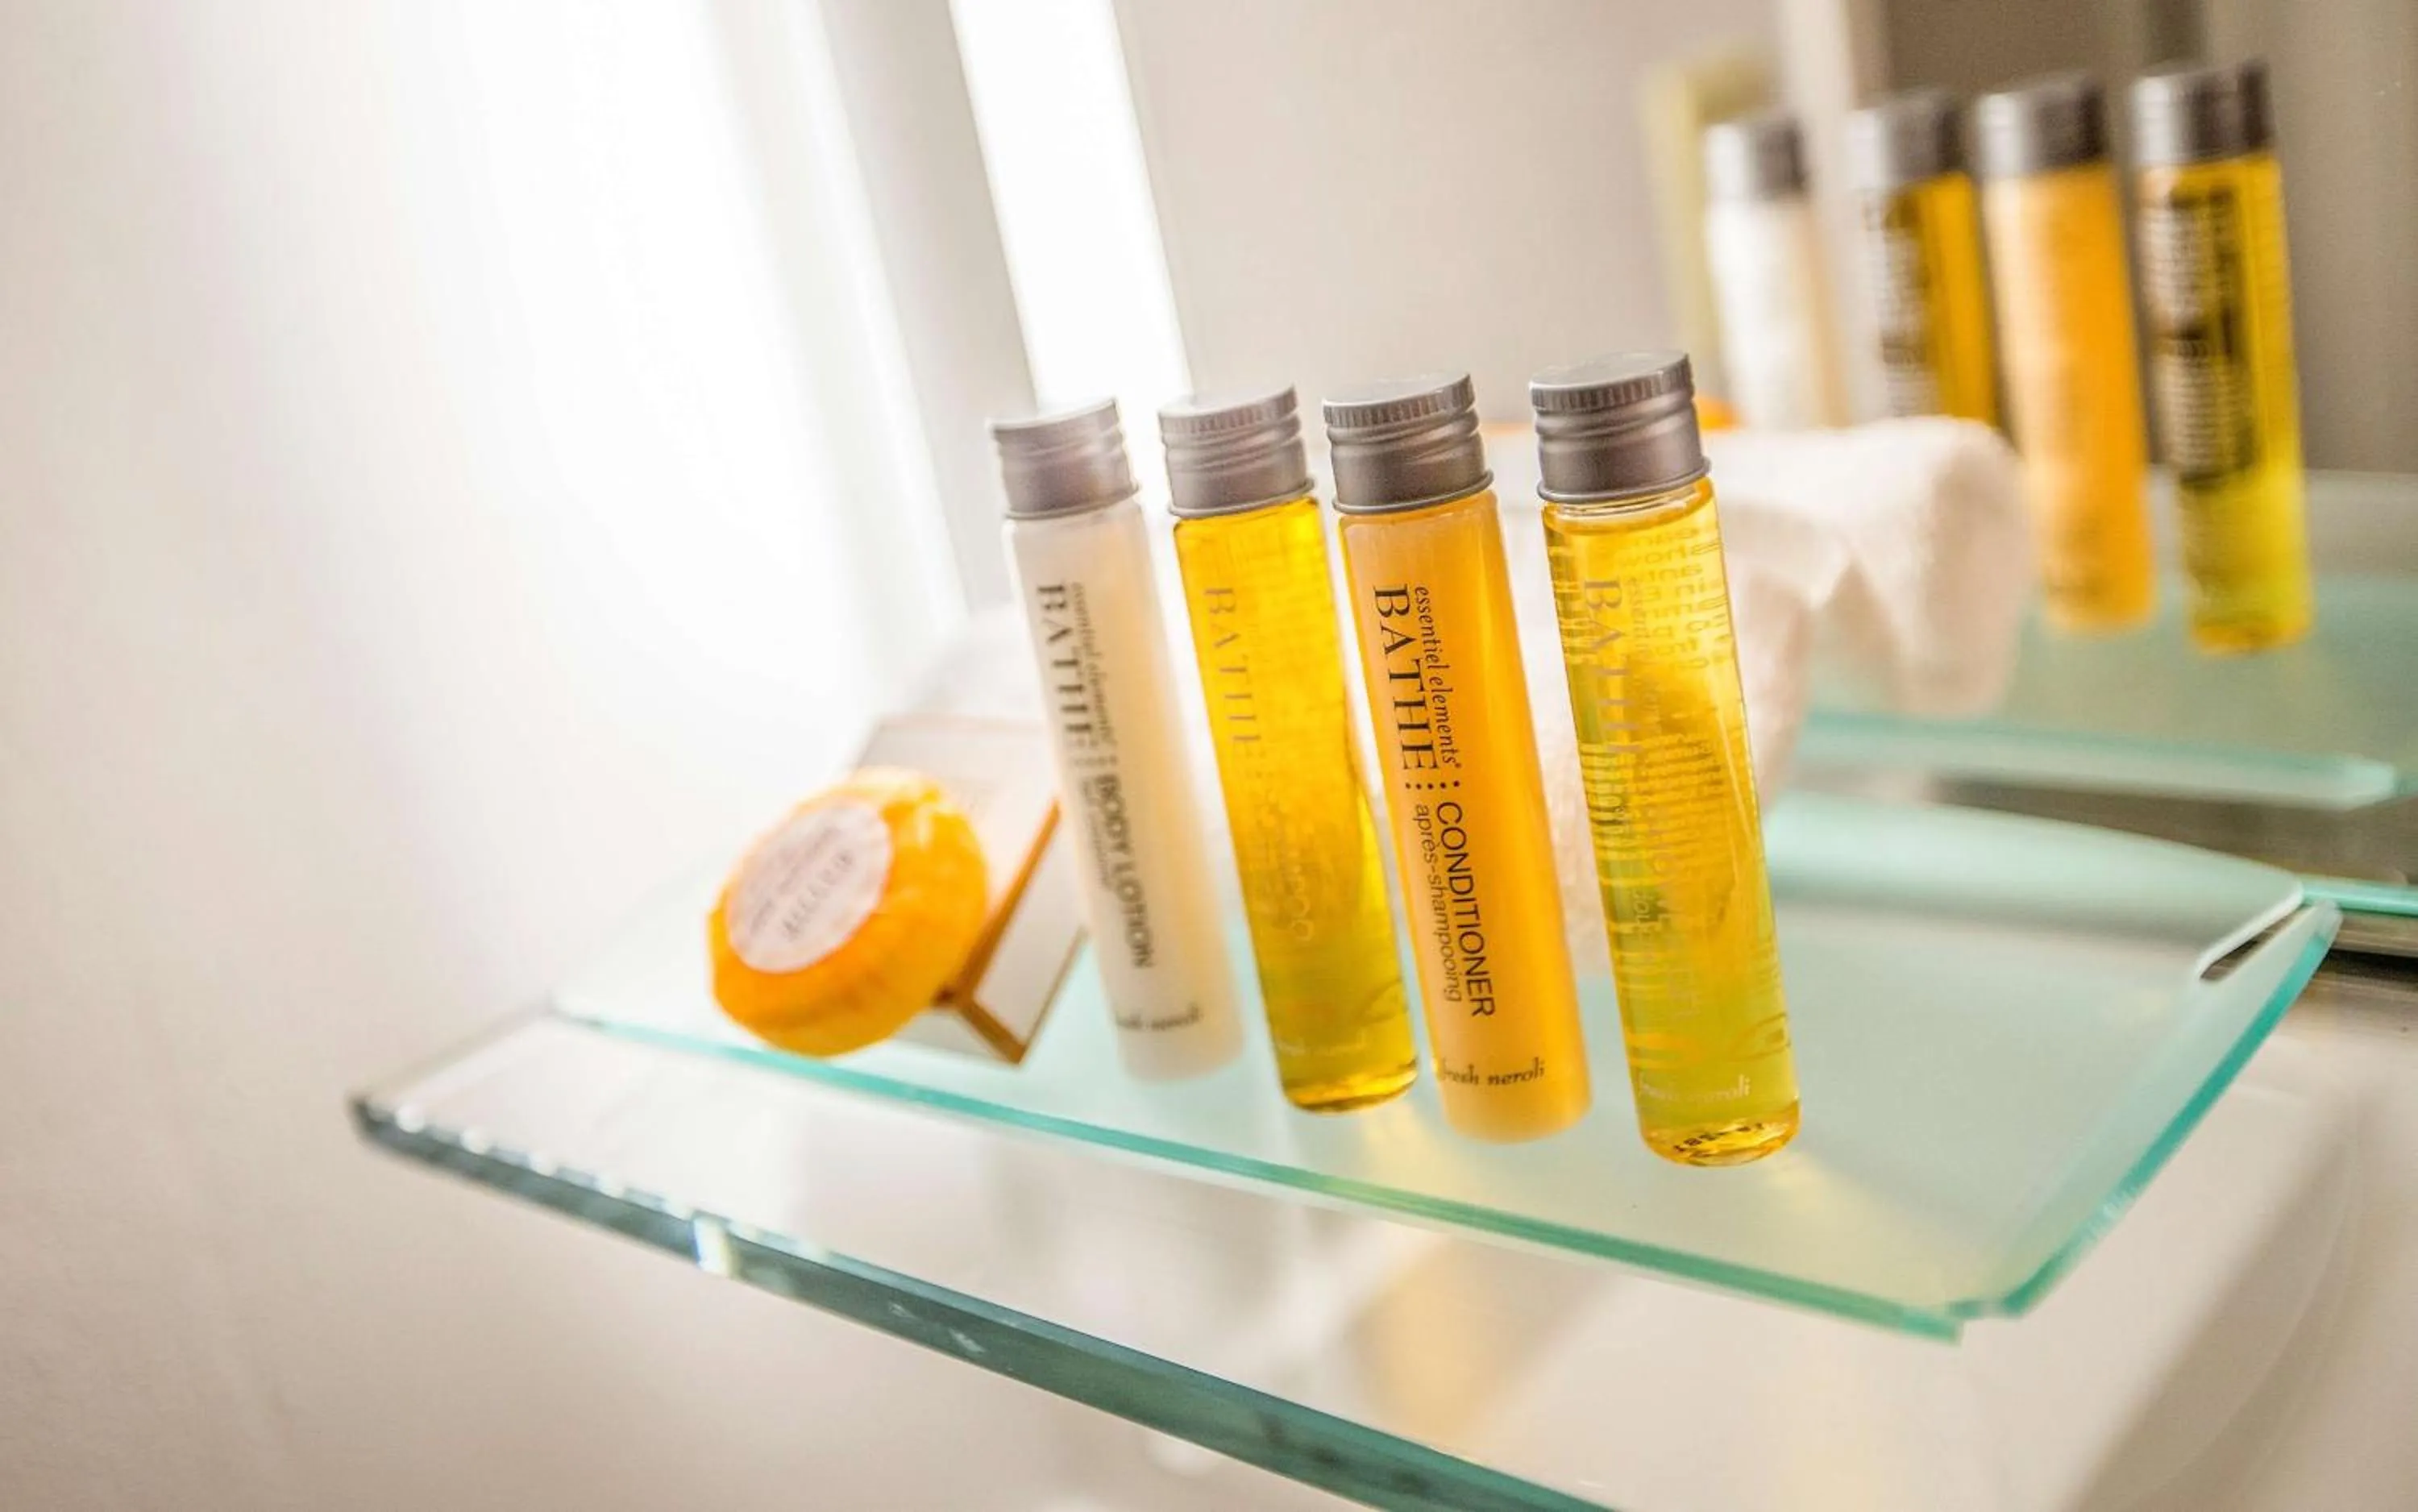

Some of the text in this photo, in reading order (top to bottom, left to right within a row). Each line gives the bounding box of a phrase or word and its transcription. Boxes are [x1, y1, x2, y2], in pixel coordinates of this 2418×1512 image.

[1036, 581, 1101, 750] BATHE
[1373, 583, 1440, 771] BATHE
[1415, 586, 1450, 670] essentiel
[1094, 774, 1135, 856] BODY
[1109, 860, 1156, 969] LOTION
[1413, 804, 1463, 1003] après-shampooing
[1436, 801, 1496, 1018] CONDITIONER
[1487, 1056, 1546, 1086] neroli
